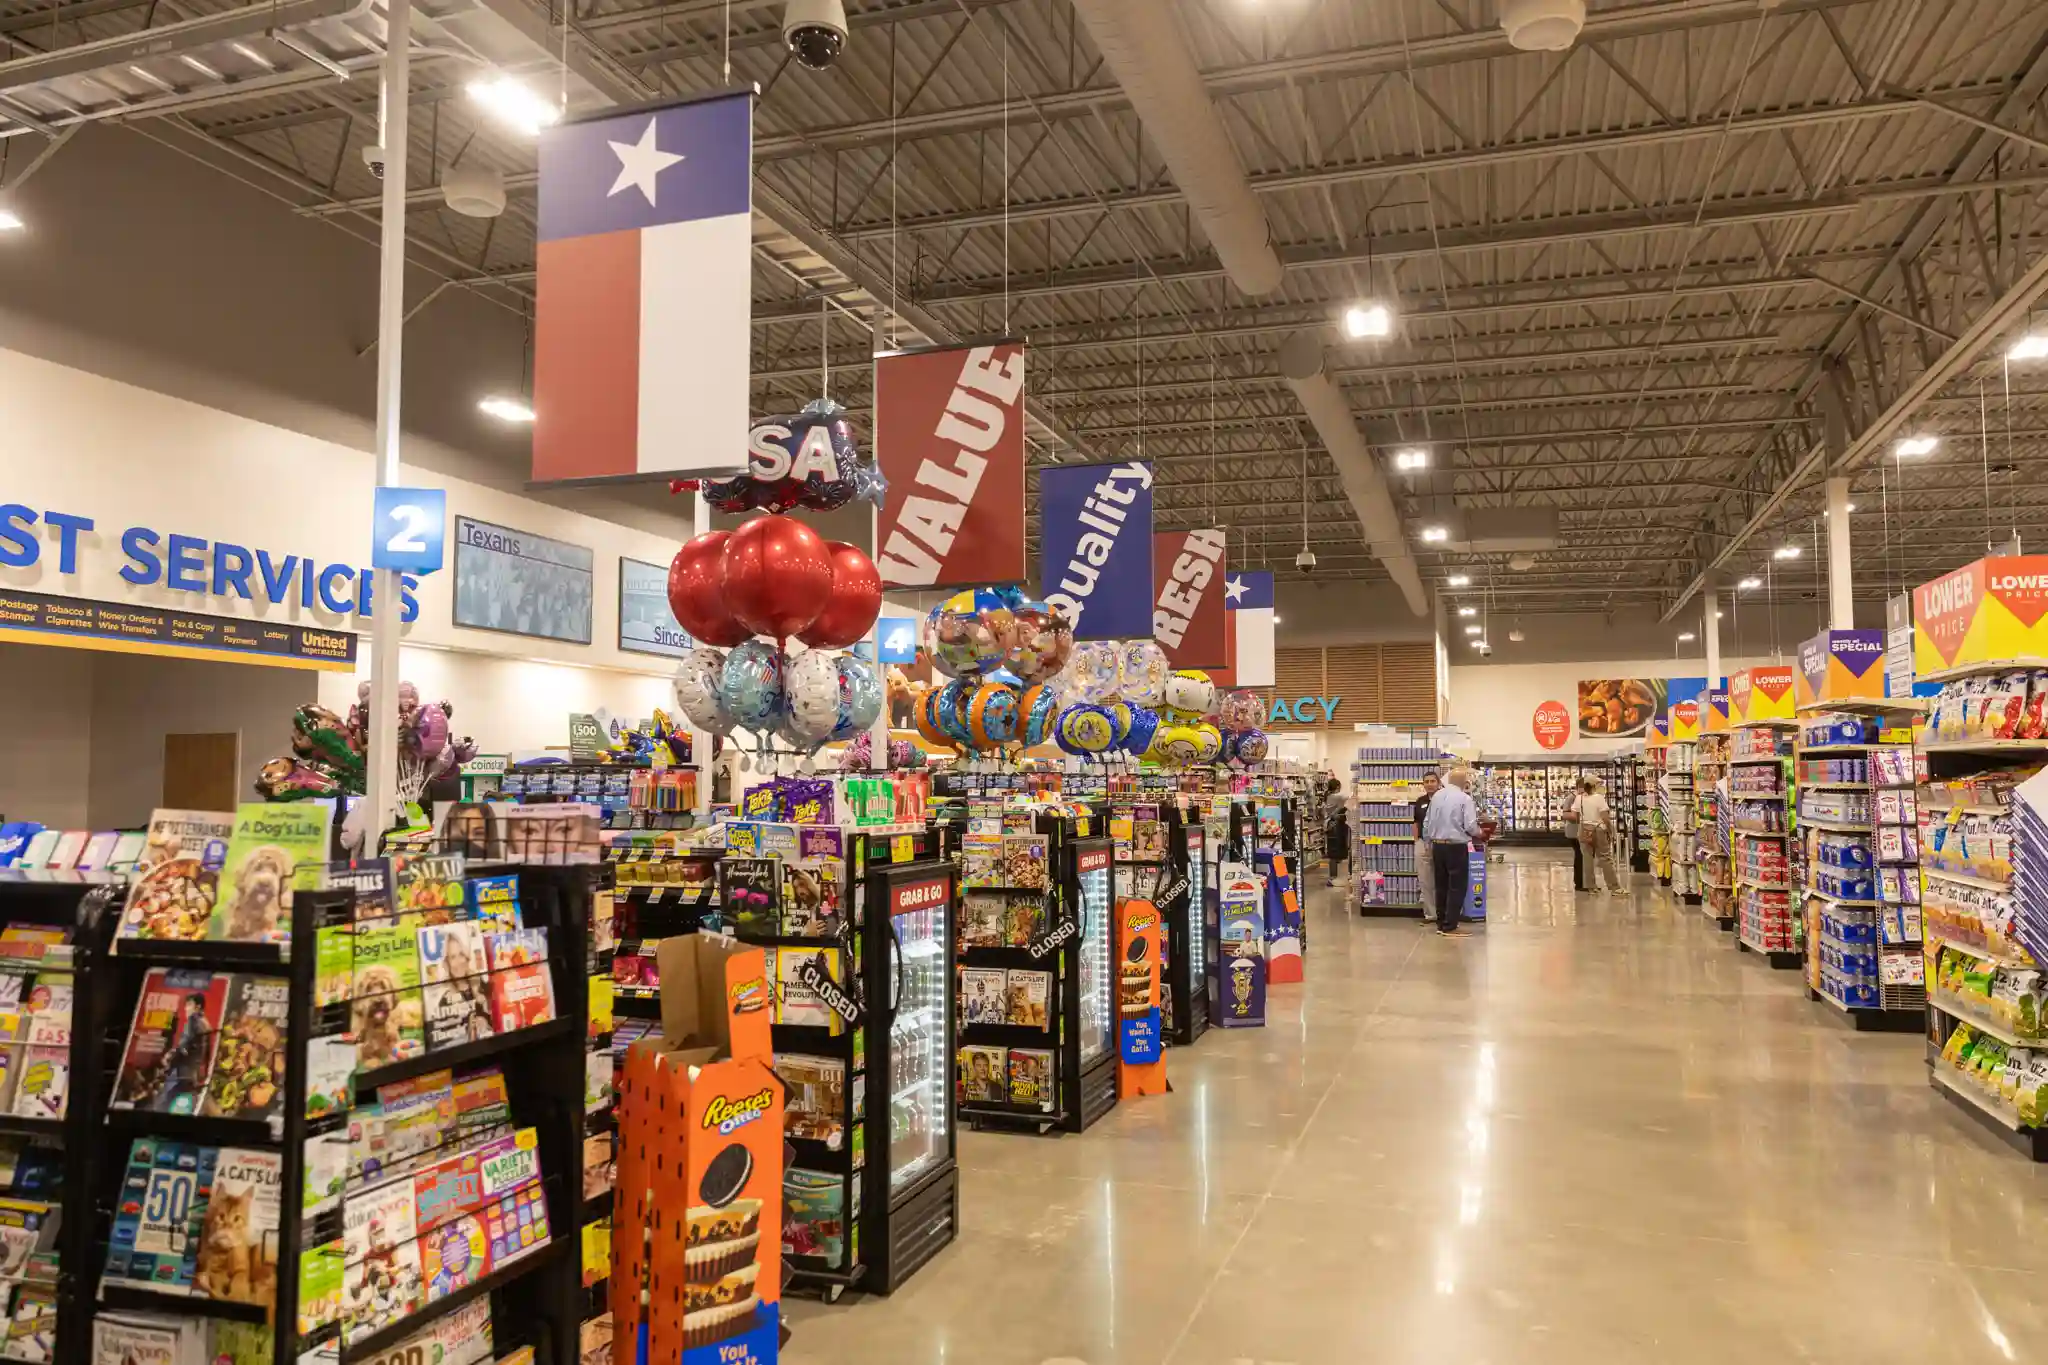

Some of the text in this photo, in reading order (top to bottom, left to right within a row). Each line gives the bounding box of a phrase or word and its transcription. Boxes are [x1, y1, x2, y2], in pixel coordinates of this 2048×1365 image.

[878, 346, 1024, 586] VALUE
[386, 504, 427, 552] 2
[0, 503, 94, 574] ST
[463, 522, 521, 555] Texans
[1044, 461, 1153, 632] Quality
[0, 599, 39, 611] Postage
[1923, 572, 1974, 621] LOWER
[0, 610, 36, 622] Stamps
[46, 604, 93, 617] Tobacco &
[99, 611, 164, 625] Money Orders &
[45, 616, 93, 628] Cigarettes
[98, 621, 157, 635] Wire Transfers
[172, 619, 187, 628] Fax
[195, 622, 215, 632] Copy
[1934, 616, 1965, 640] PRICE
[172, 629, 205, 641] Services
[223, 636, 258, 646] Payments
[264, 630, 289, 641] Lottery
[302, 632, 347, 650] United
[655, 626, 686, 647] Since
[884, 628, 908, 651] 4
[302, 647, 347, 657] supermarkets
[1831, 643, 1883, 652] SPECIAL
[1755, 675, 1792, 685] LOWER
[1268, 696, 1341, 722] ACY
[572, 724, 597, 738] 1,500
[470, 759, 505, 772] coinstar
[239, 820, 321, 837] A Dog's Life
[409, 856, 464, 881] SALAD
[1081, 855, 1093, 869] GRAB
[1098, 853, 1106, 865] GO
[900, 884, 942, 907] GRAB & GO
[1156, 880, 1188, 910] CLOSED
[1127, 914, 1156, 929] Reese's
[354, 942, 390, 957] Dog's
[1030, 922, 1076, 959] CLOSED
[804, 967, 859, 1023] CLOSED
[702, 1088, 774, 1130] Reese's
[483, 1149, 533, 1178] VARIETY
[218, 1165, 228, 1178] A
[228, 1166, 263, 1184] CAT'S
[147, 1172, 192, 1226] 50
[718, 1343, 748, 1364] You
